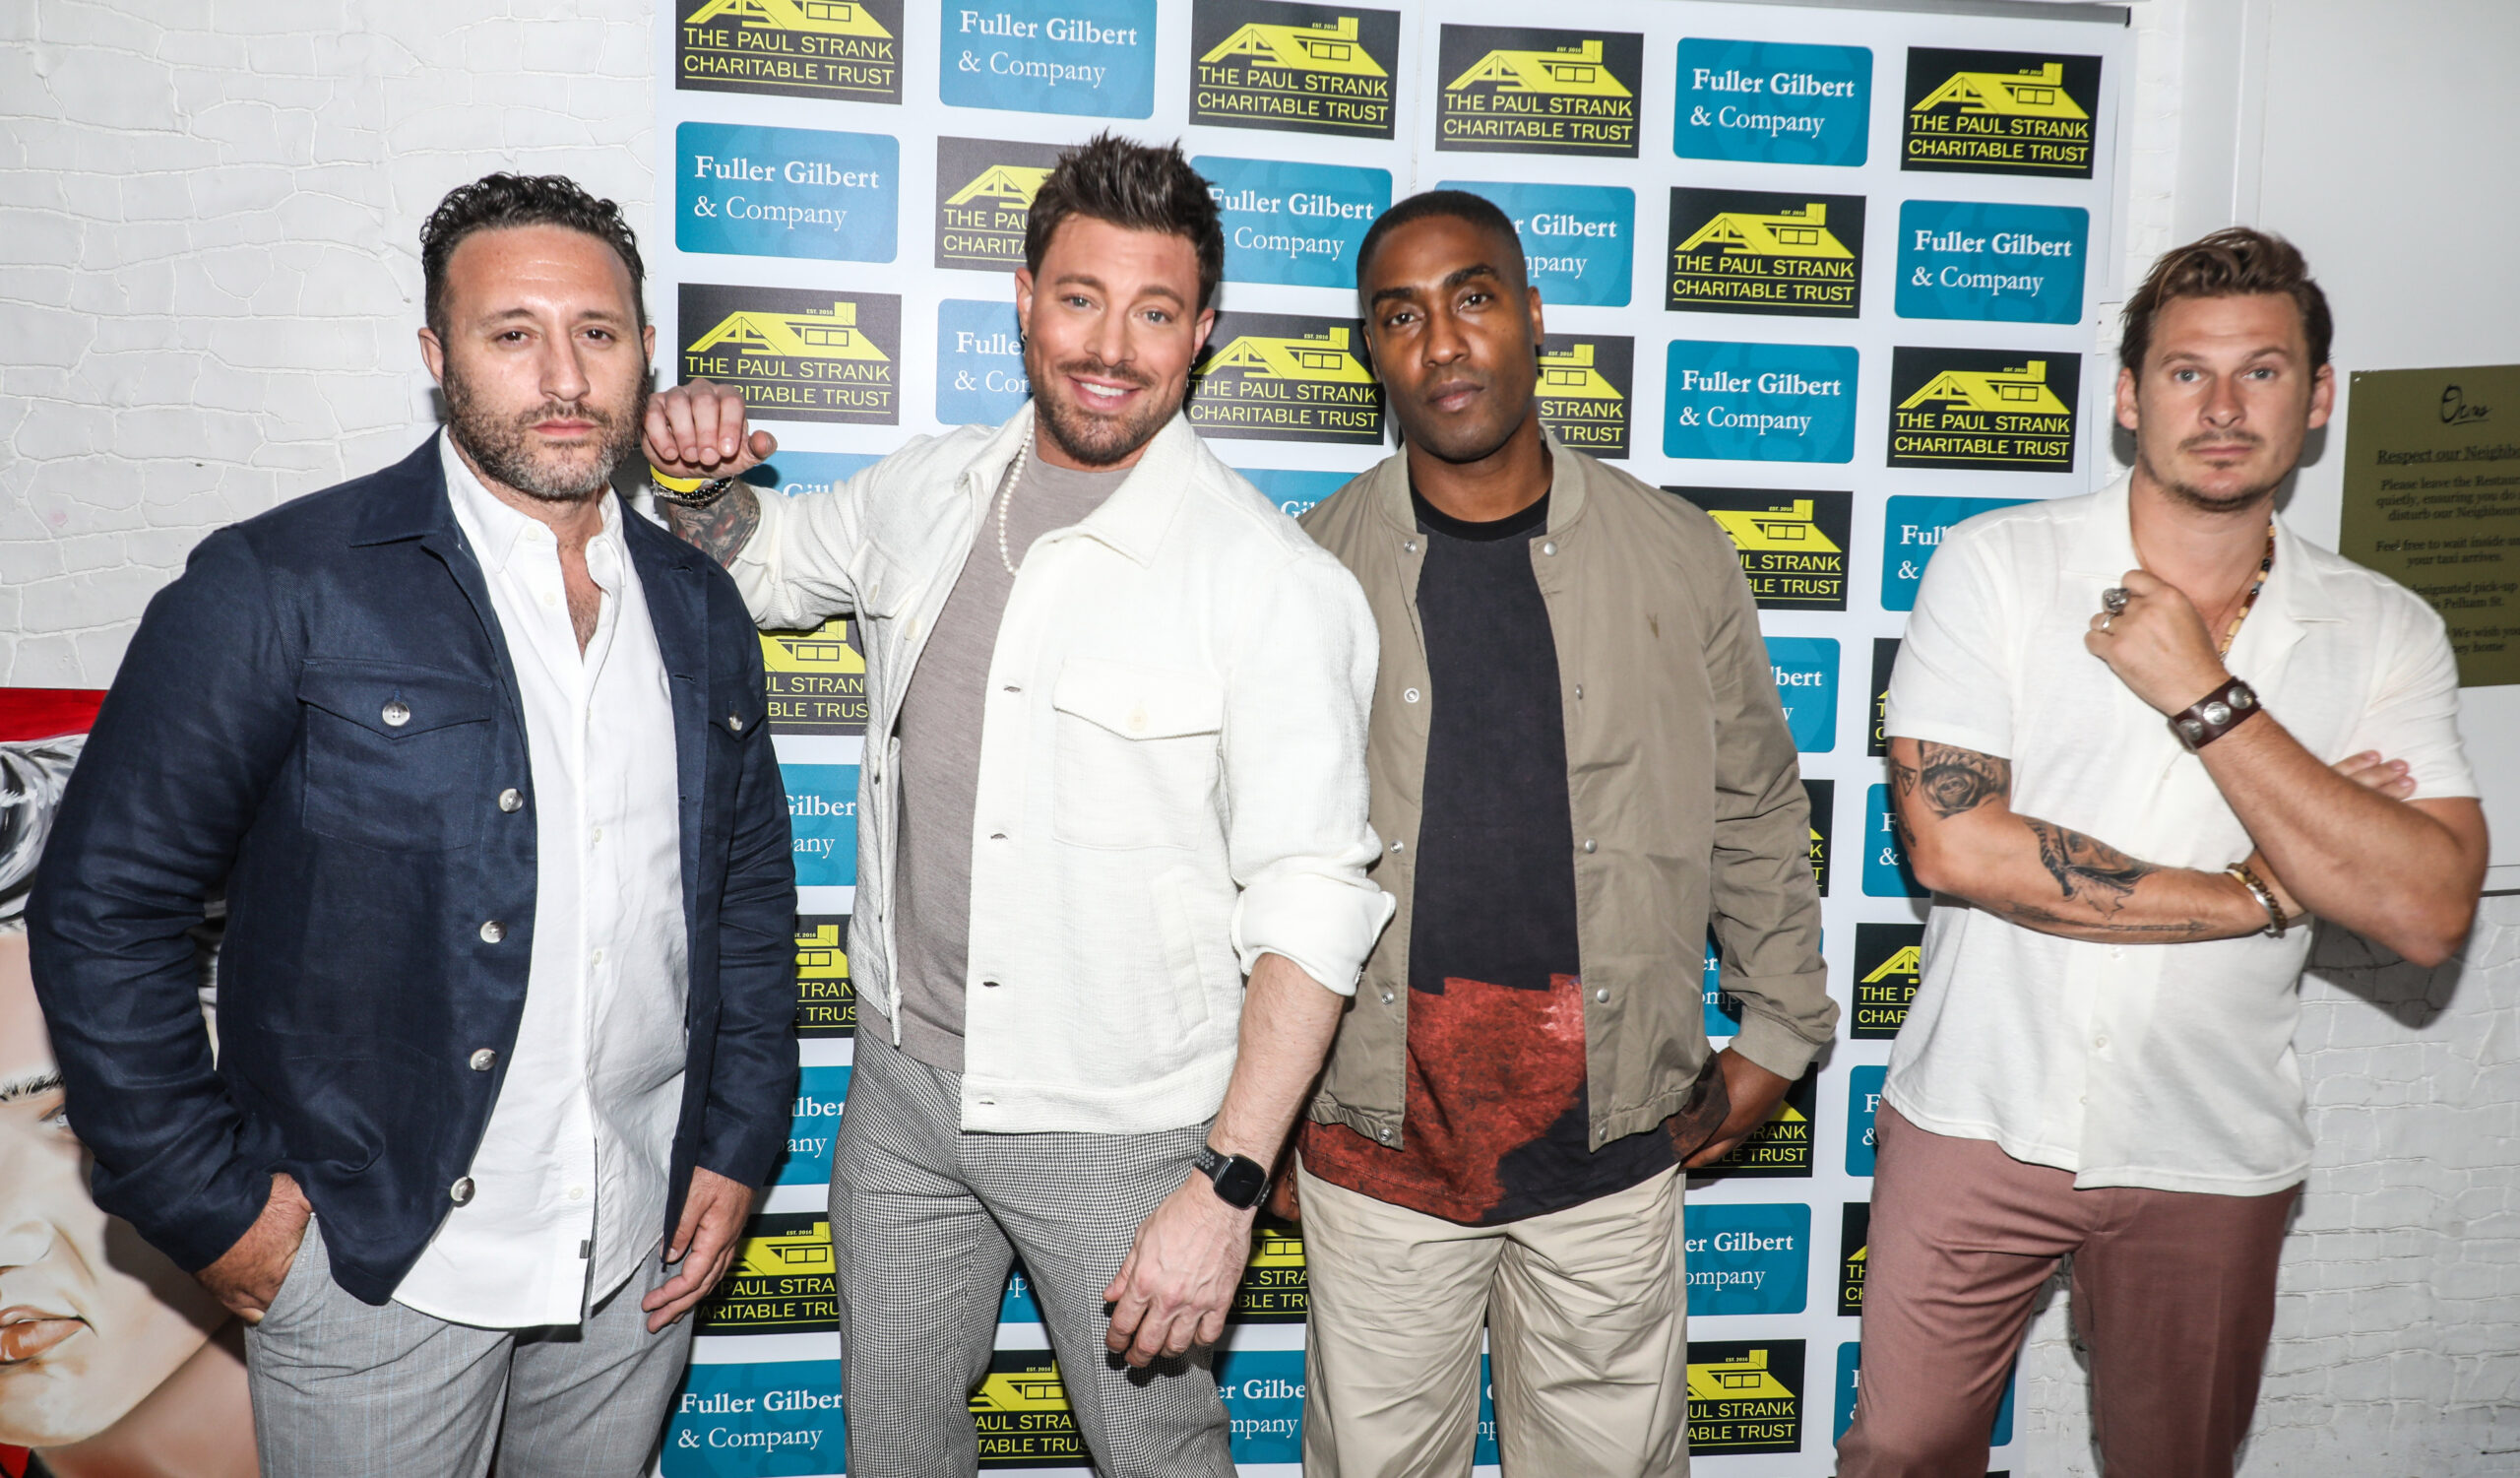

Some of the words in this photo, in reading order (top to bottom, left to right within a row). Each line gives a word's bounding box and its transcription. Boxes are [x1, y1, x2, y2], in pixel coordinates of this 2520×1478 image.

[960, 11, 1038, 37] Fuller
[1046, 19, 1137, 45] Gilbert
[684, 28, 728, 46] THE
[737, 32, 793, 51] PAUL
[801, 35, 893, 59] STRANK
[684, 55, 817, 79] CHARITABLE
[825, 65, 894, 85] TRUST
[959, 51, 980, 72] &
[990, 51, 1105, 89] Company
[1199, 66, 1239, 85] THE
[1247, 69, 1299, 90] PAUL
[1305, 74, 1388, 96] STRANK
[1692, 69, 1763, 93] Fuller
[1770, 73, 1854, 96] Gilbert
[1197, 92, 1320, 116] CHARITABLE
[1326, 101, 1388, 120] TRUST
[1445, 94, 1484, 110] THE
[1492, 95, 1544, 112] PAUL
[1549, 97, 1632, 115] STRANK
[1444, 119, 1564, 138] CHARITABLE
[1571, 123, 1633, 140] TRUST
[1690, 105, 1711, 126] &
[1719, 106, 1825, 138] Company
[1911, 114, 1949, 131] THE
[1956, 116, 2005, 134] PAUL
[2011, 119, 2088, 137] STRANK
[1909, 139, 2024, 159] CHARITABLE
[2030, 145, 2088, 161] TRUST
[695, 156, 776, 181] Fuller
[785, 161, 879, 188] Gilbert
[694, 196, 717, 217] &
[725, 197, 847, 231] Company
[1289, 193, 1373, 220] Gilbert
[945, 209, 986, 227] THE
[1531, 214, 1616, 237] Gilbert
[1233, 226, 1344, 261] Company
[1915, 230, 1985, 252] Fuller
[1992, 233, 2071, 256] Gilbert
[1675, 254, 1713, 272] THE
[1720, 257, 1767, 275] PAUL
[1774, 260, 1854, 277] STRANK
[1673, 280, 1788, 298] CHARITABLE
[1794, 285, 1854, 300] TRUST
[1912, 267, 1932, 286] &
[1940, 266, 2044, 296] Company
[956, 332, 1020, 355] Fulle
[685, 356, 728, 374] THE
[737, 358, 791, 376] PAUL
[799, 361, 890, 380] STRANK
[955, 370, 976, 391] &
[1190, 379, 1232, 397] THE
[1239, 382, 1291, 399] PAUL
[1297, 385, 1377, 402] STRANK
[1681, 370, 1751, 392] Fuller
[1758, 373, 1841, 396] Gilbert
[823, 388, 891, 406] TRUST
[1190, 405, 1311, 424] CHARITABLE
[1318, 411, 1378, 426] TRUST
[1542, 401, 1623, 418] STRANK
[1679, 407, 1699, 425] &
[1707, 407, 1811, 436] Company
[1898, 413, 1935, 428] THE
[1942, 414, 1989, 430] PAUL
[1995, 416, 2069, 432] STRANK
[1563, 425, 1622, 441] TRUST
[1895, 436, 2008, 454] CHARITABLE
[2015, 440, 2070, 456] TRUST
[2377, 449, 2431, 464] Respect
[2435, 450, 2461, 461] our
[2380, 479, 2418, 490] Please
[2421, 477, 2451, 488] leave
[2453, 476, 2471, 486] the
[2375, 540, 2401, 551] Feel
[2403, 539, 2426, 551] free
[2427, 540, 2440, 549] to
[1762, 554, 1841, 570] STRANK
[1898, 560, 1919, 579] &
[1782, 579, 1841, 594] TRUST
[790, 677, 863, 693] STRAN
[1770, 667, 1822, 687] bert
[813, 702, 868, 719] TRUS
[1879, 848, 1898, 866] &
[797, 982, 853, 997] TRAN
[1861, 987, 1898, 1000] THE
[809, 1006, 856, 1021] TRUS
[1750, 1147, 1807, 1162] TRUST
[1714, 1232, 1793, 1252] Gilbert
[780, 1277, 835, 1294] STRA
[1258, 1270, 1306, 1285] STRA
[1685, 1268, 1766, 1291] ompany
[802, 1302, 840, 1317] TRU
[1243, 1380, 1305, 1399] Gilbe
[679, 1393, 755, 1413] Fuller
[763, 1390, 843, 1411] Gilber
[1719, 1402, 1795, 1417] STRANK
[975, 1415, 1013, 1430] AUL
[1019, 1414, 1072, 1430] STRA
[1230, 1418, 1298, 1442] mpany
[1738, 1424, 1796, 1439] TRUST
[678, 1429, 700, 1447] &
[709, 1428, 822, 1452] Company
